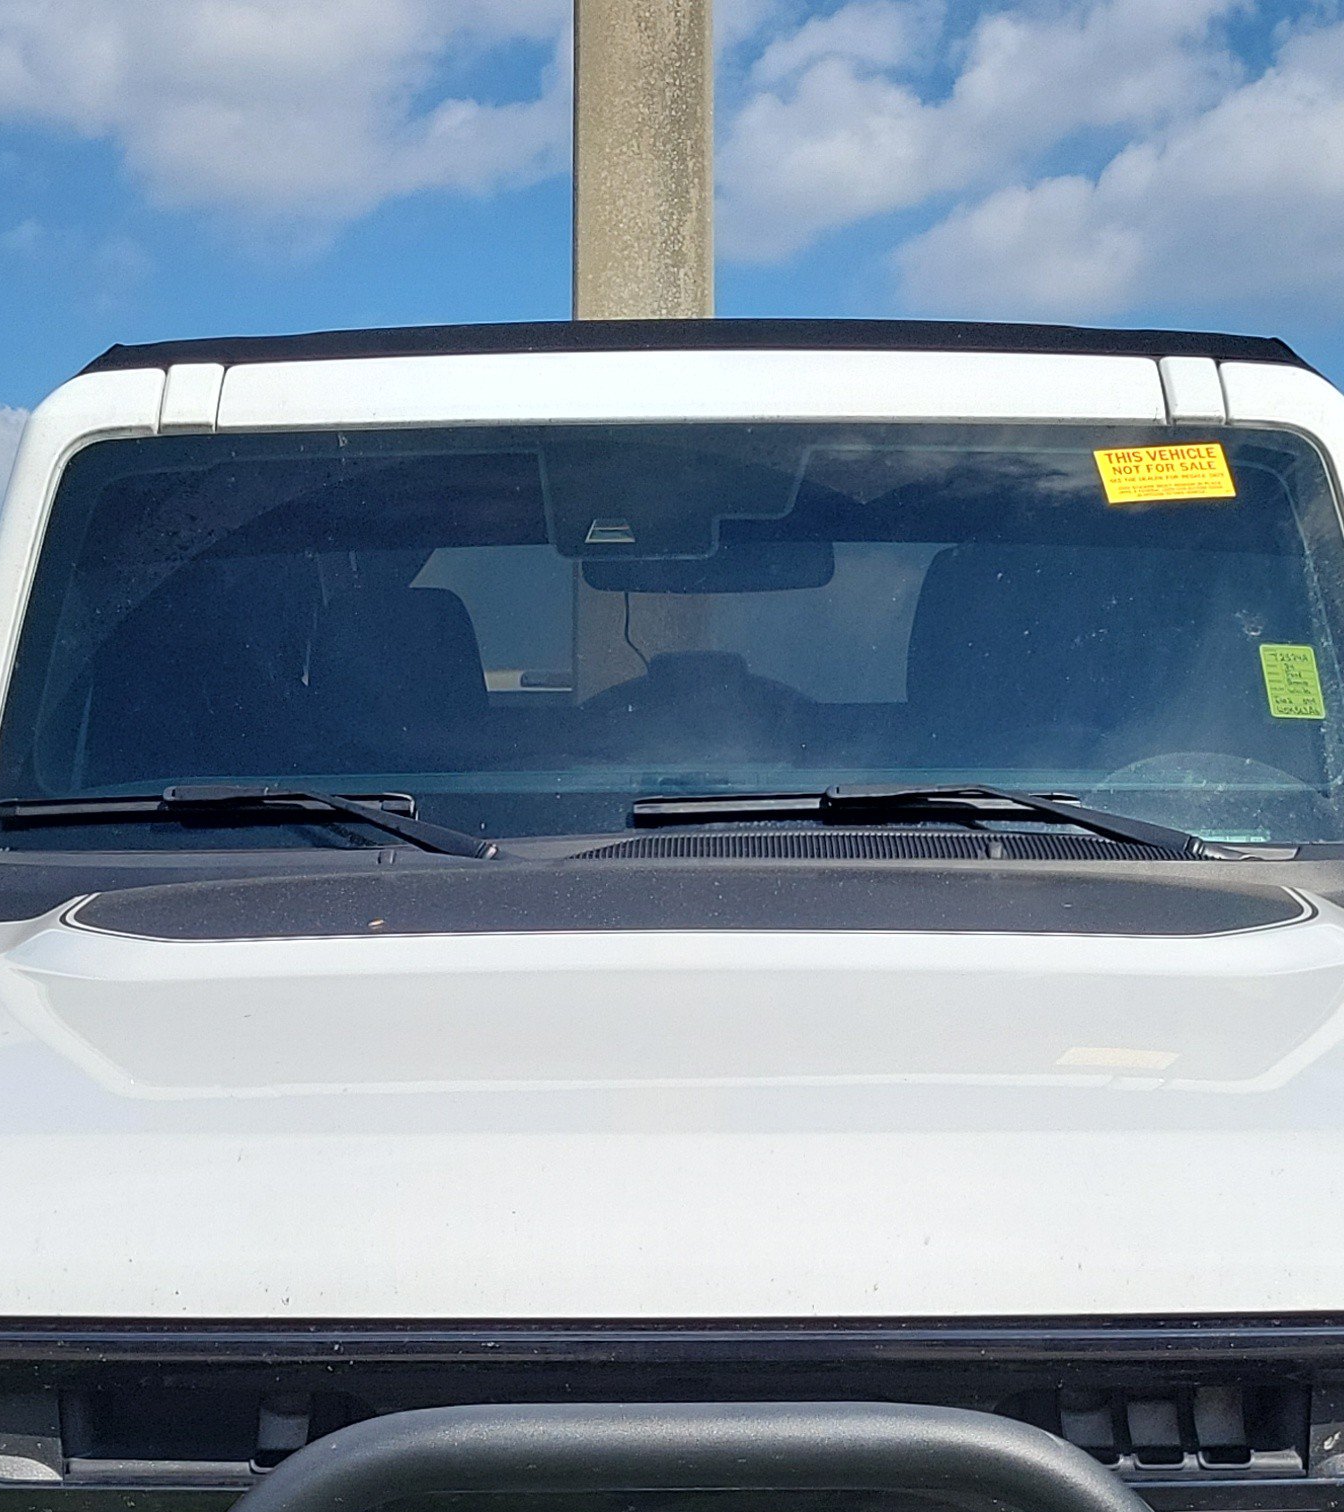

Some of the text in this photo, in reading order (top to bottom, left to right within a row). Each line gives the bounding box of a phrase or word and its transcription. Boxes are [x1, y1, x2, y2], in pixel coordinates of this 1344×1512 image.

[1104, 447, 1217, 464] THIS VEHICLE
[1112, 461, 1216, 475] NOT FOR SALE
